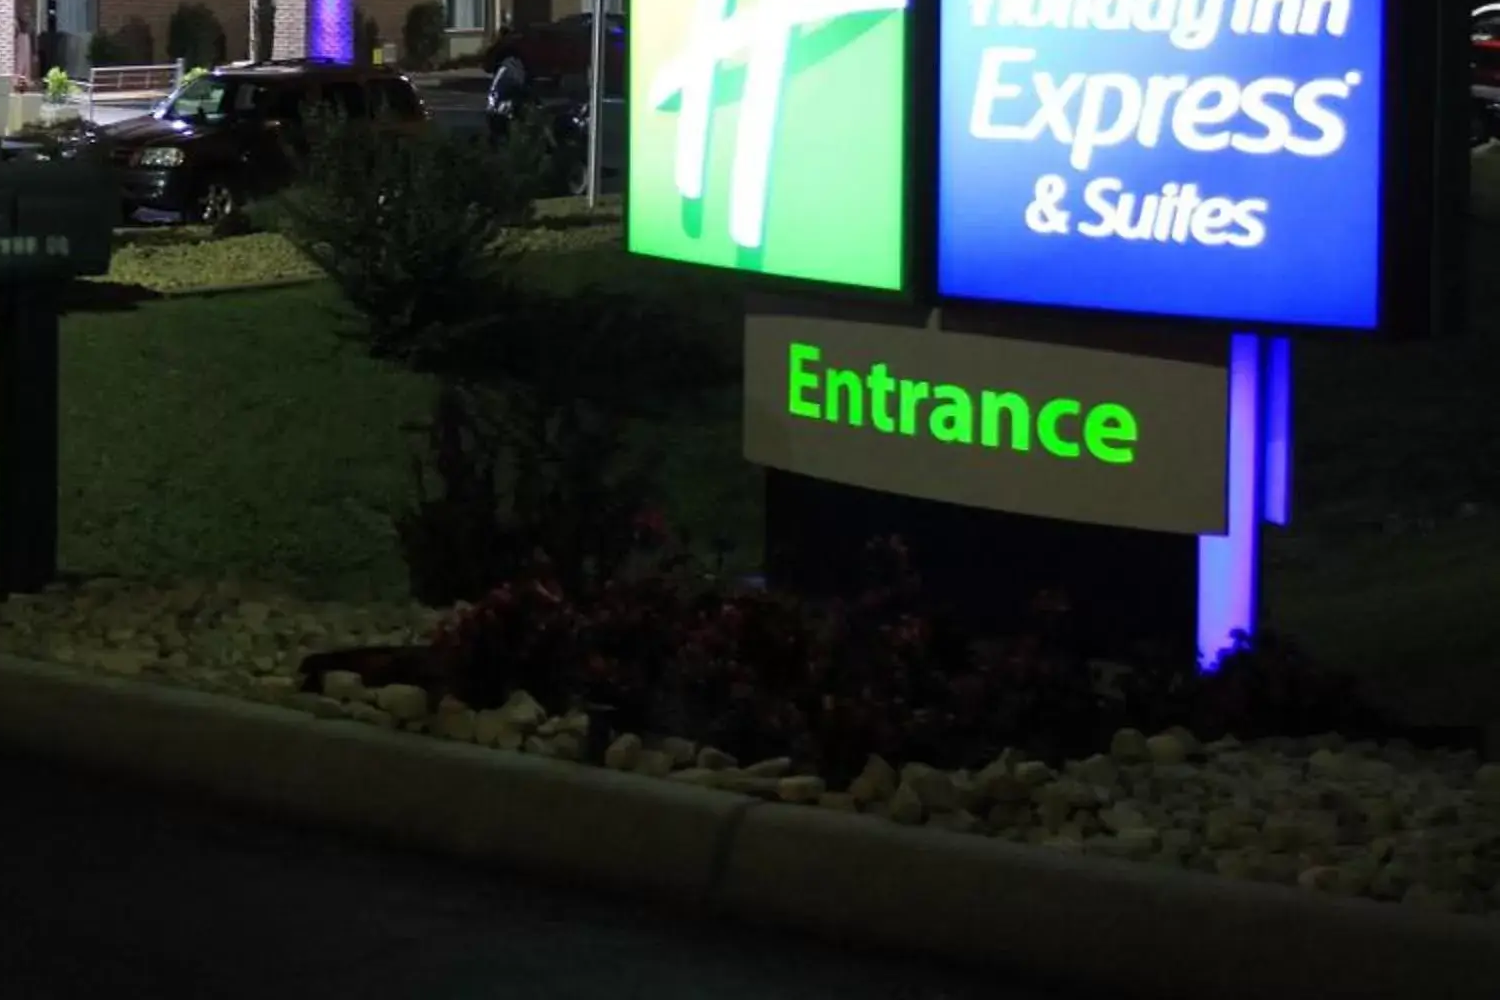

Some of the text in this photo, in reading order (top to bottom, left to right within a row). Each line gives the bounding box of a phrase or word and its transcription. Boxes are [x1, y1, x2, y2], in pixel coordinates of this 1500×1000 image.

[969, 46, 1353, 171] Express
[1024, 174, 1269, 248] & Suites
[788, 340, 1139, 464] Entrance
